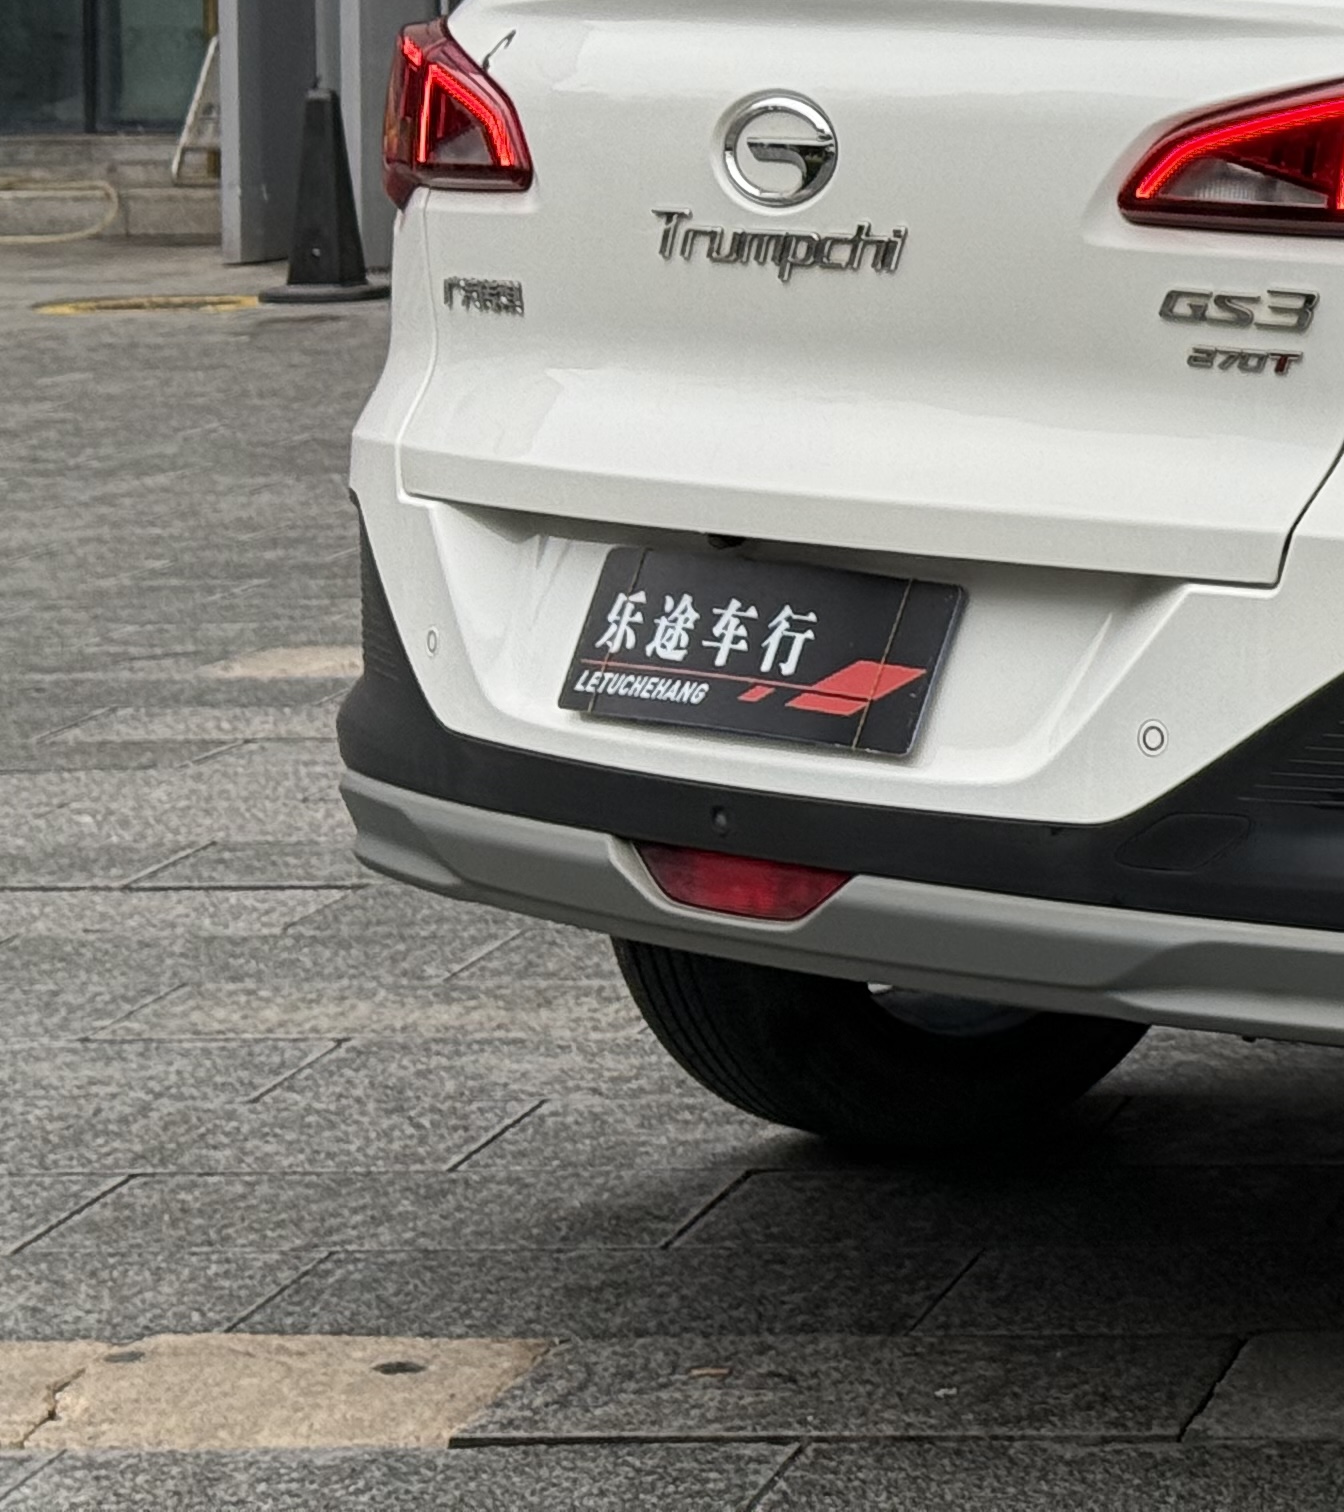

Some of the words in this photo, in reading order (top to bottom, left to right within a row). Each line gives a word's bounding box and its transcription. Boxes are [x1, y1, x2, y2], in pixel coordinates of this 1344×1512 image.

[651, 208, 909, 282] Trumpchi
[1159, 287, 1320, 332] GS3
[1187, 345, 1303, 376] 270T
[595, 590, 818, 676] 乐途车行
[574, 670, 710, 704] LETUCHEHANG
